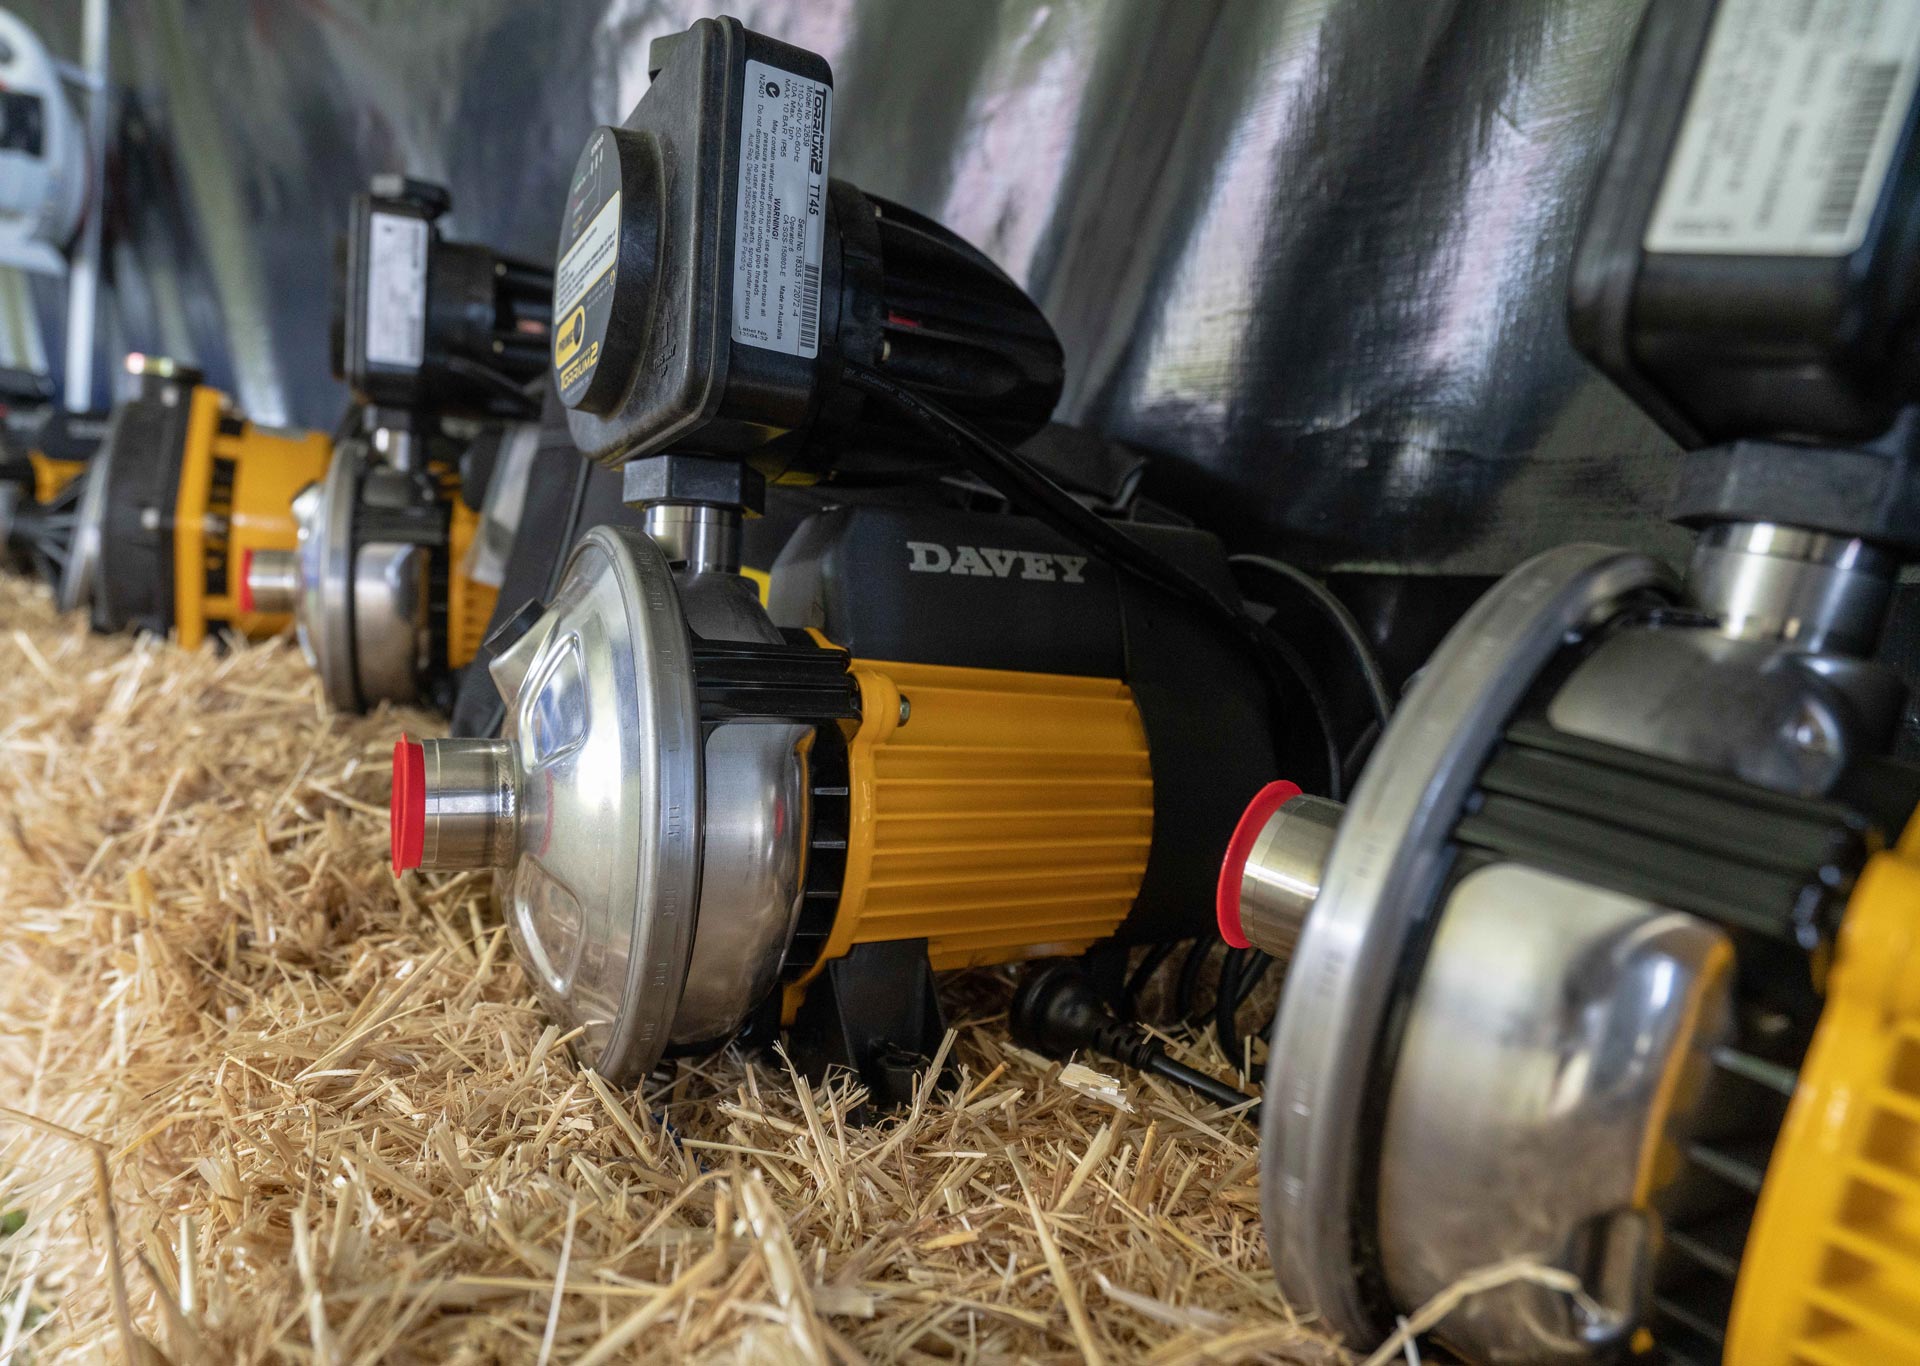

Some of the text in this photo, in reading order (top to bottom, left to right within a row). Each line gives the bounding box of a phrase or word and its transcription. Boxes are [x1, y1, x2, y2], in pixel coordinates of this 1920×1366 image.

[756, 104, 763, 115] Do
[782, 102, 789, 113] 10
[770, 119, 778, 135] May
[793, 127, 801, 163] 50-60Hz
[753, 164, 758, 173] no
[808, 184, 820, 216] TT45
[771, 198, 781, 240] WARNING!
[782, 214, 788, 225] CA
[906, 541, 1088, 582] DAVEY
